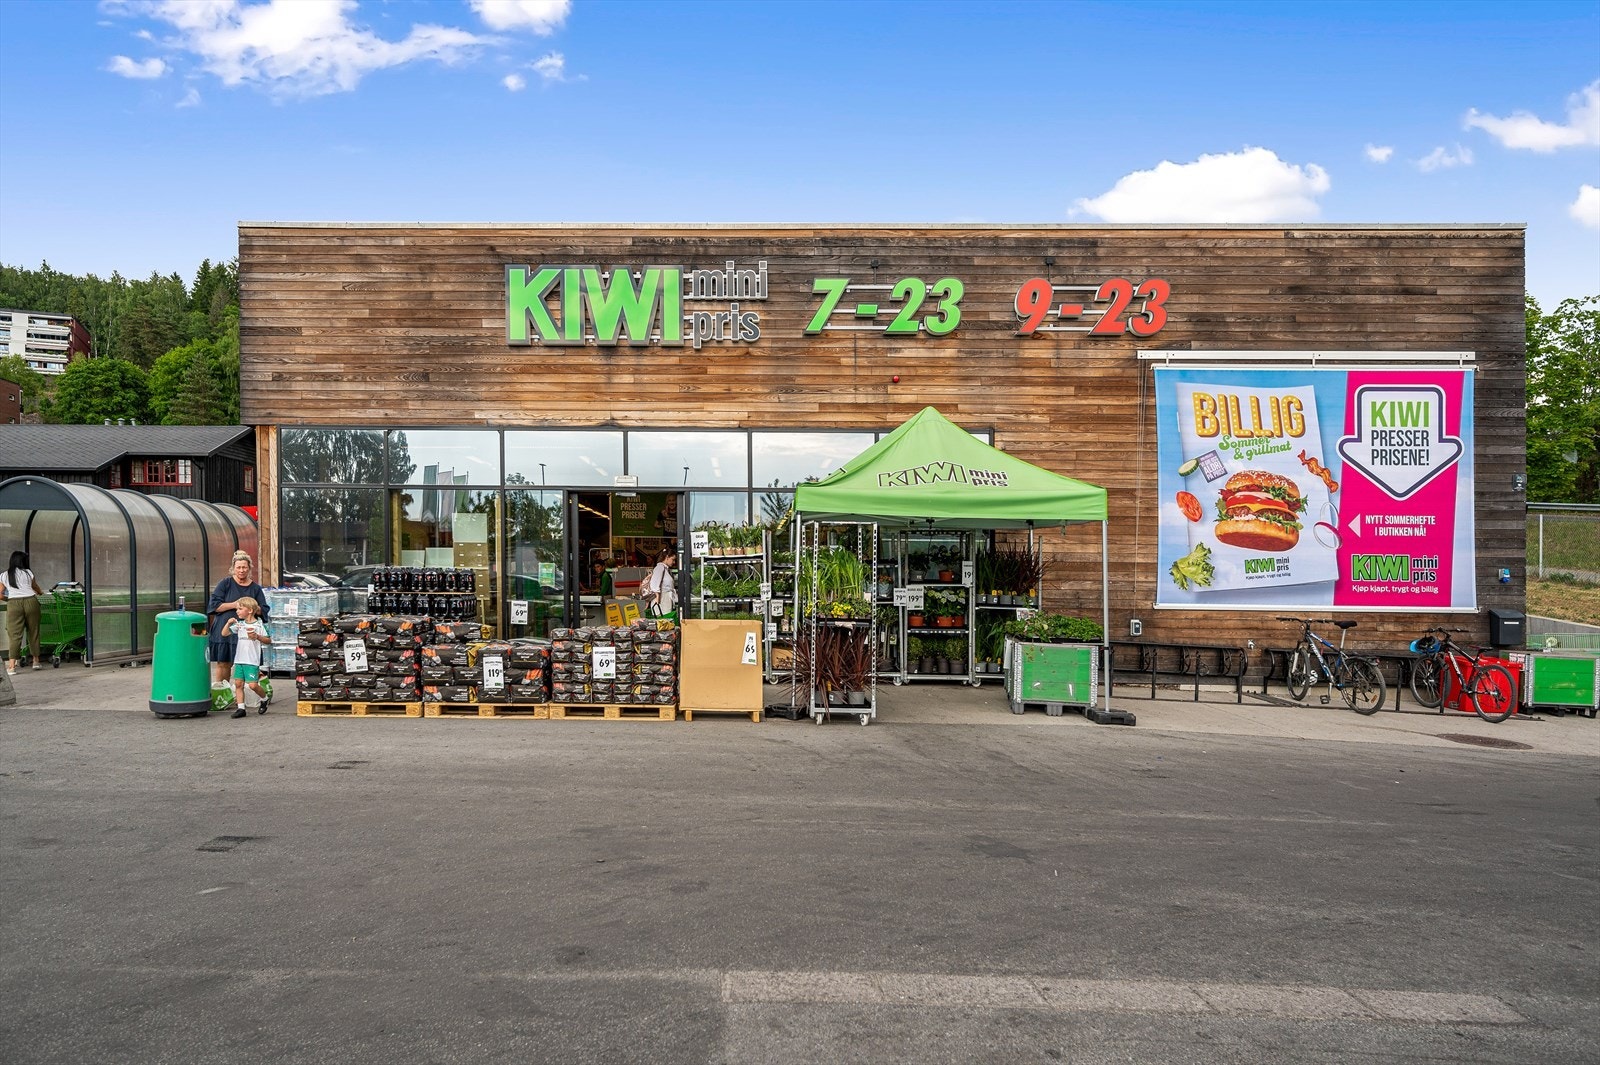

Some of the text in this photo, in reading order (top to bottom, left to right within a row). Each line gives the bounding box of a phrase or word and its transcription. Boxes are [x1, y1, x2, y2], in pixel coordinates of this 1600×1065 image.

[505, 261, 768, 346] KIWI mini
[692, 303, 761, 349] pris
[1192, 392, 1306, 438] BILLIG
[1370, 401, 1430, 428] KIWI
[1371, 430, 1430, 447] PRESSER
[1233, 447, 1244, 461] &
[1245, 440, 1292, 461] grillmat
[1371, 449, 1430, 466] PRISENE!
[878, 461, 1007, 488] KIWI mini
[971, 477, 1008, 487] pris
[620, 502, 647, 511] PRESSER
[1365, 515, 1436, 525] NYTT SOMMERHEFTE
[1379, 527, 1413, 537] BUTIKKEN
[1414, 525, 1427, 537] NÅ!
[1244, 557, 1290, 574] KIWI mini
[1276, 564, 1290, 572] pris
[1352, 554, 1439, 582] KIWI mini
[1412, 569, 1437, 585] pris
[1352, 585, 1369, 593] Kjøp
[1392, 586, 1409, 594] trygt
[1421, 586, 1439, 594] billig
[515, 609, 524, 617] 69
[351, 651, 361, 662] 59
[599, 659, 610, 668] 69
[488, 668, 500, 678] 119
